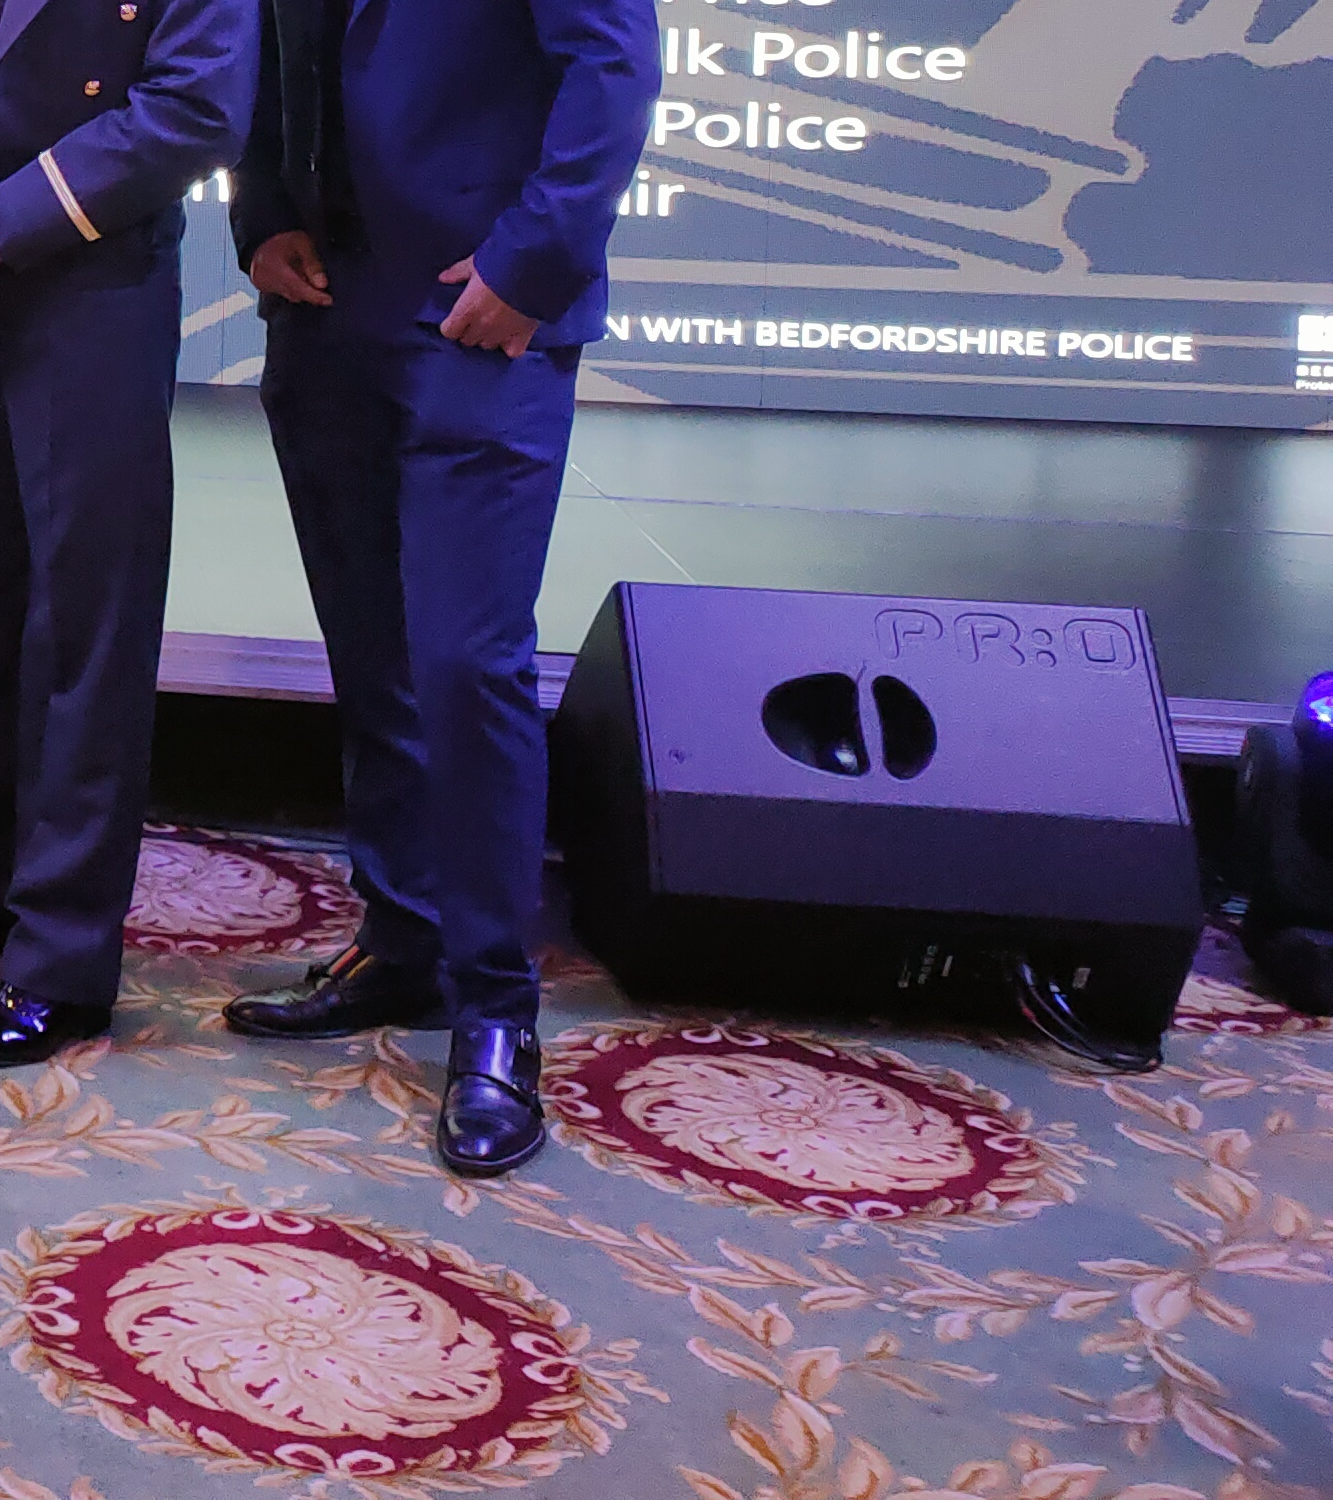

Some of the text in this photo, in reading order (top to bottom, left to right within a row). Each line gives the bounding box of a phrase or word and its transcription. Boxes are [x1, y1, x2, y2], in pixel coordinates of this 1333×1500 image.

[751, 30, 967, 81] Police
[653, 100, 867, 152] Police
[640, 315, 742, 345] WITH
[755, 320, 1046, 357] BEDFORDSHIRE
[1058, 332, 1194, 362] POLICE
